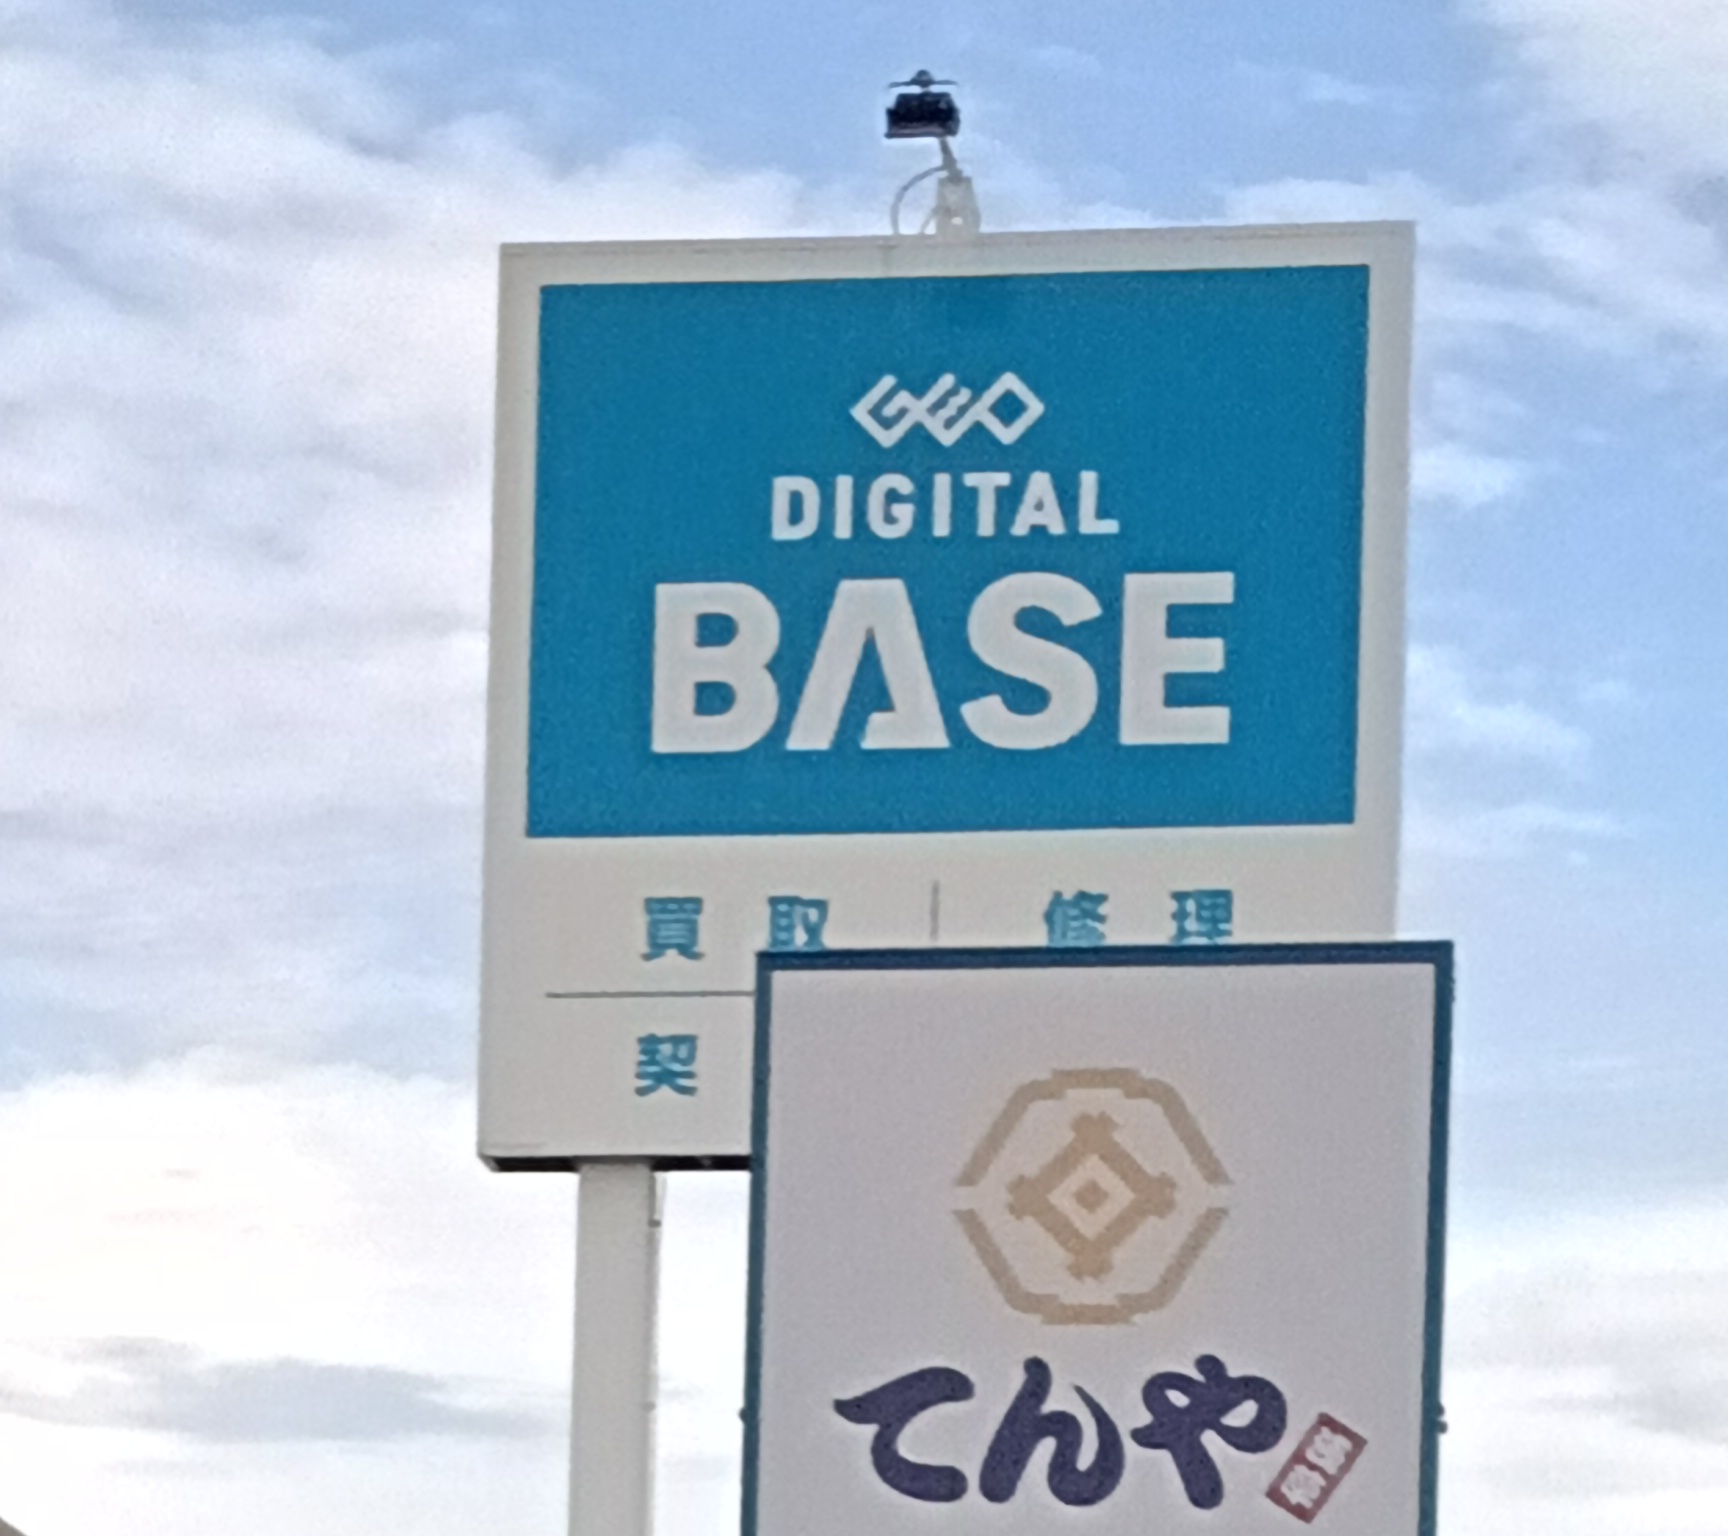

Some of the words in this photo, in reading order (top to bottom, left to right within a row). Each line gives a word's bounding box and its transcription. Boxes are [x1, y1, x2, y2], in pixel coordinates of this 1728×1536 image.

[770, 470, 1120, 542] DIGITAL
[650, 571, 1236, 754] BASE
[641, 895, 829, 961] 買取
[833, 1354, 1288, 1510] てんや
